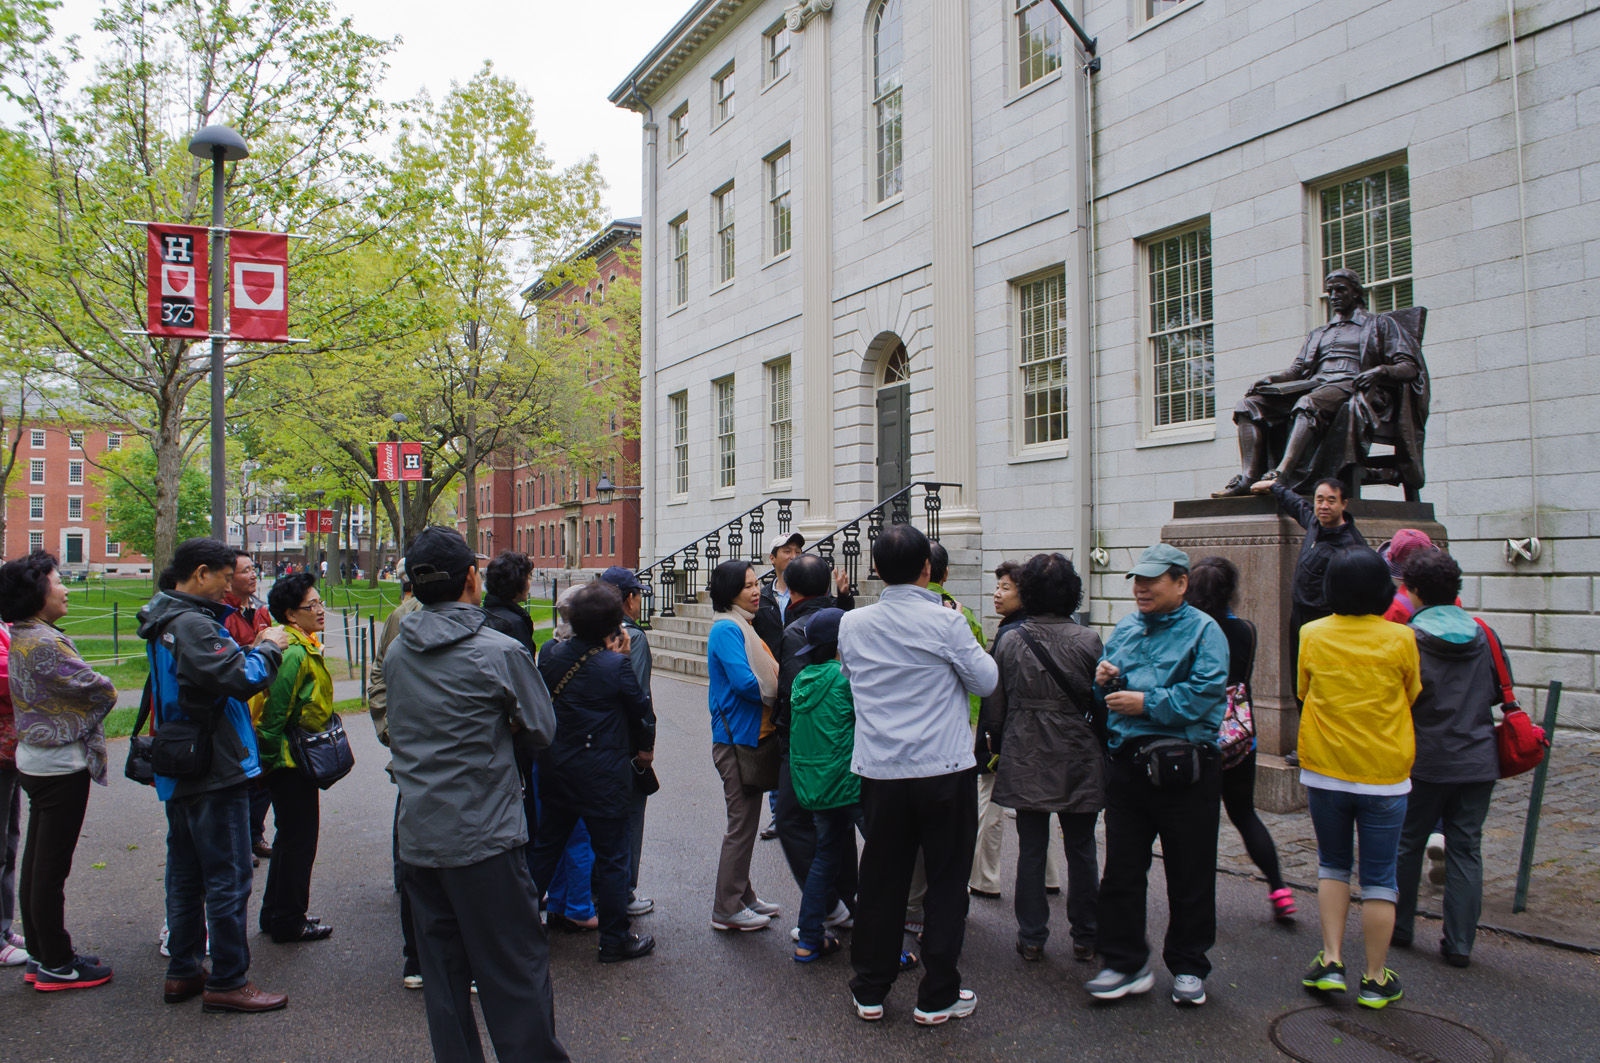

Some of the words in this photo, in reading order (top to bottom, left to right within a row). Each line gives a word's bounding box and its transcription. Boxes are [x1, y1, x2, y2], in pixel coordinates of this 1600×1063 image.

[165, 236, 190, 262] H
[161, 303, 195, 323] 375
[384, 444, 393, 480] celebrate
[405, 454, 419, 469] H
[320, 517, 333, 525] 375
